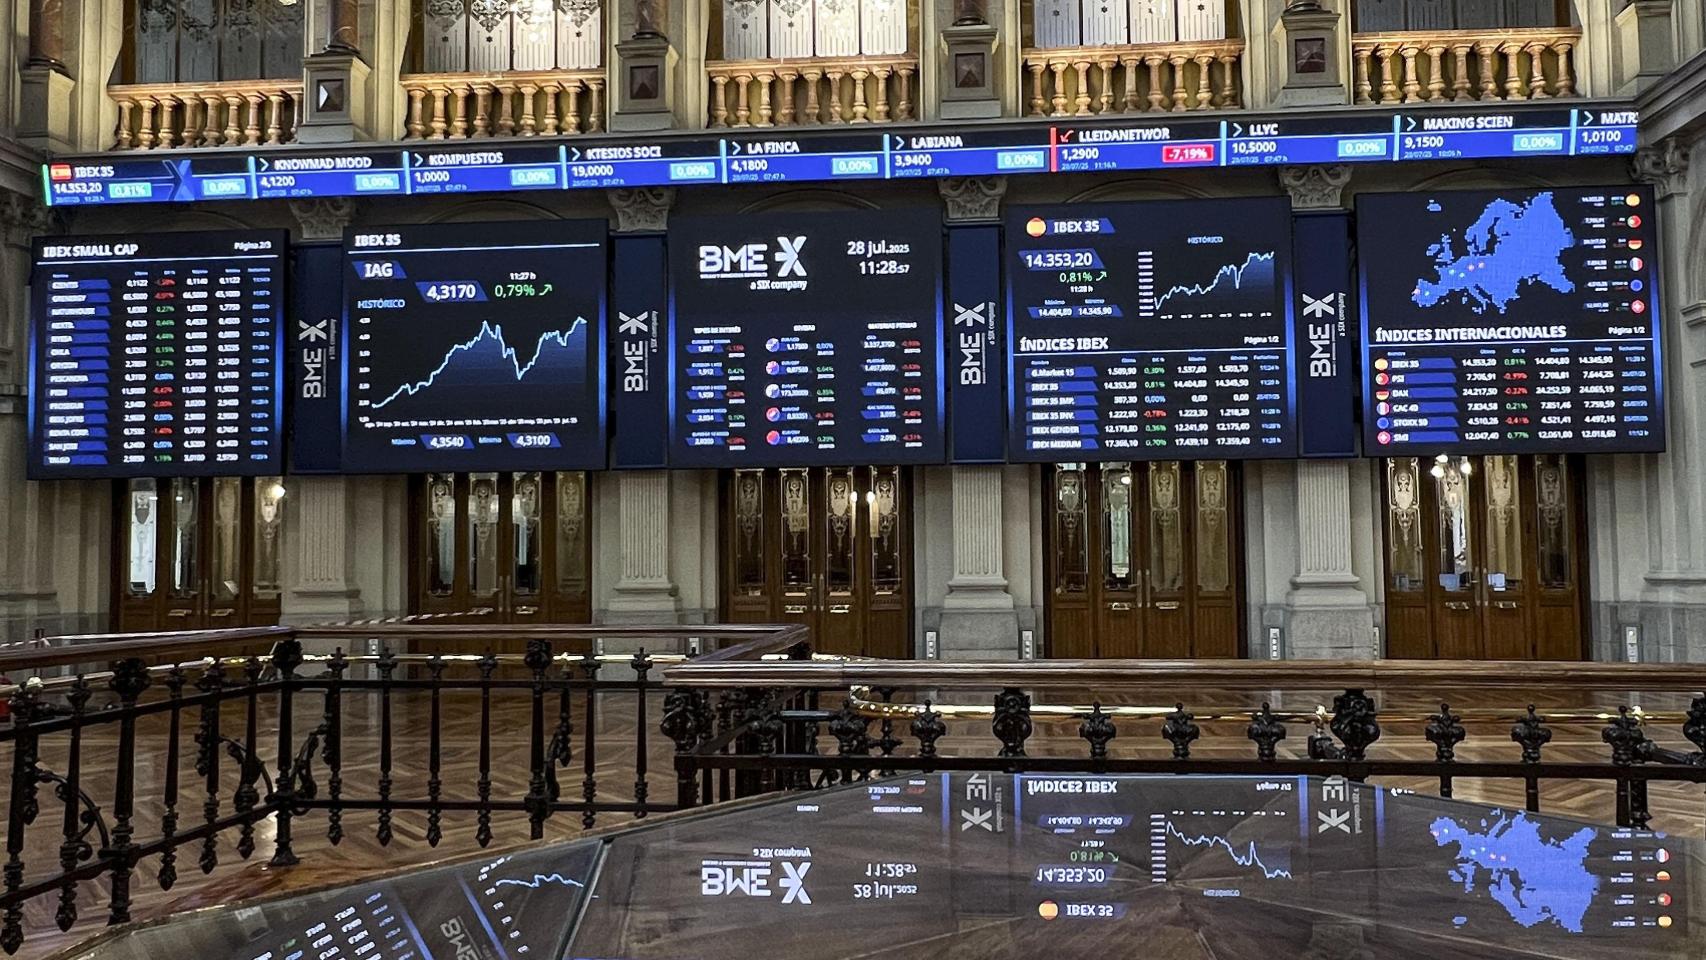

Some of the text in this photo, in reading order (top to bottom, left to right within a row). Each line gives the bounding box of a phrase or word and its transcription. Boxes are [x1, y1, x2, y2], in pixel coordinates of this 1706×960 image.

[1424, 116, 1513, 131] MAKING SCIEN
[1601, 111, 1638, 124] MATR
[1079, 128, 1170, 142] LLEIDANETWOR
[1249, 124, 1279, 136] LLYC
[911, 136, 963, 149] LABIANA
[1404, 136, 1556, 149] 9,1500 0,00%
[1582, 131, 1621, 144] 1,0100
[586, 146, 662, 160] KTESIOS SOCI
[748, 141, 800, 154] LA FINCA
[1232, 142, 1380, 154] 10,5000 0,00%
[429, 153, 503, 166] KOMPUESTOS
[895, 155, 1038, 167] 3,9400 0,00%
[1062, 148, 1208, 161] 1,2900 -7,19%
[275, 157, 372, 171] KNOWMAD MOOD
[731, 160, 872, 173] 4,1800 0,00%
[75, 166, 100, 179] IBEX
[415, 171, 450, 183] 1,0000
[572, 165, 709, 178] 19,0000 0,00%
[261, 176, 295, 188] 4,1200
[1054, 220, 1100, 233] IBEX 35
[355, 235, 384, 247] IBEX
[43, 244, 139, 258] IBEX SMALL CAP
[847, 241, 865, 255] 28
[699, 243, 768, 273] BME
[1025, 252, 1093, 268] 14.353,20
[364, 263, 393, 278] IAG
[510, 273, 528, 281] 11:27
[1060, 272, 1093, 284] 0,81%
[495, 285, 535, 299] 0,79%
[750, 280, 807, 291] a SIX company
[427, 285, 476, 300] 4,3170
[1338, 292, 1346, 320] company
[1337, 321, 1346, 332] SIX
[1608, 326, 1645, 336] Página 1/2
[1376, 325, 1567, 342] ÍNDICES INTERNACIONALES
[1020, 336, 1109, 352] ÍNDICES IBEX
[1308, 323, 1332, 377] BME
[960, 332, 981, 385] BME
[624, 340, 644, 392] BME
[304, 348, 322, 398] BME
[1392, 389, 1409, 398] DAX
[430, 436, 550, 448] 4,3540 4,3100
